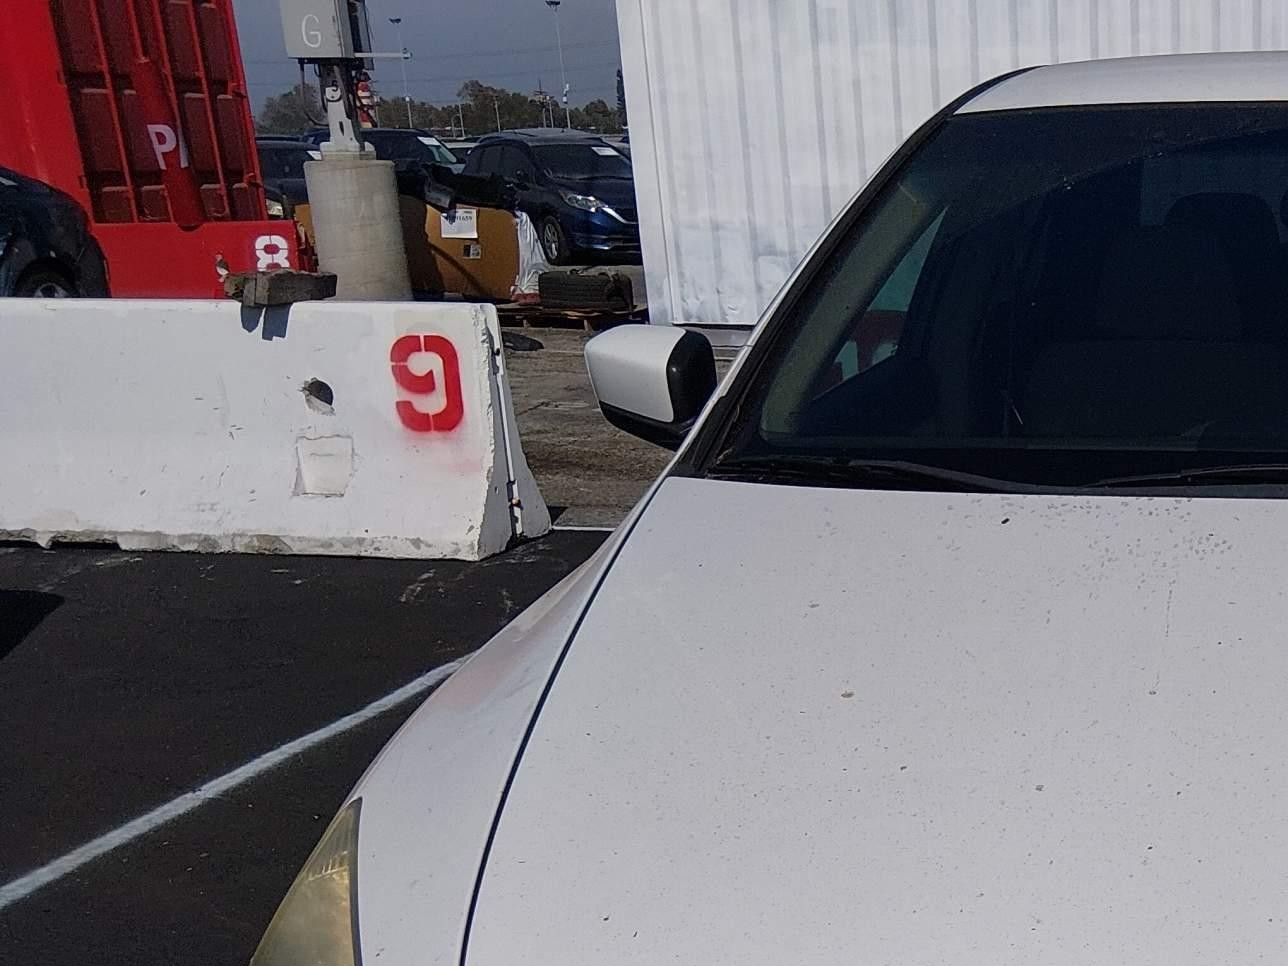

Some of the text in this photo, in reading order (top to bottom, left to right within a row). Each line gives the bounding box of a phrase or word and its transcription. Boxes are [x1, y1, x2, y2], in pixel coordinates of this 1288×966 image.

[302, 14, 322, 48] G
[255, 235, 290, 272] 8
[389, 335, 465, 432] 9
